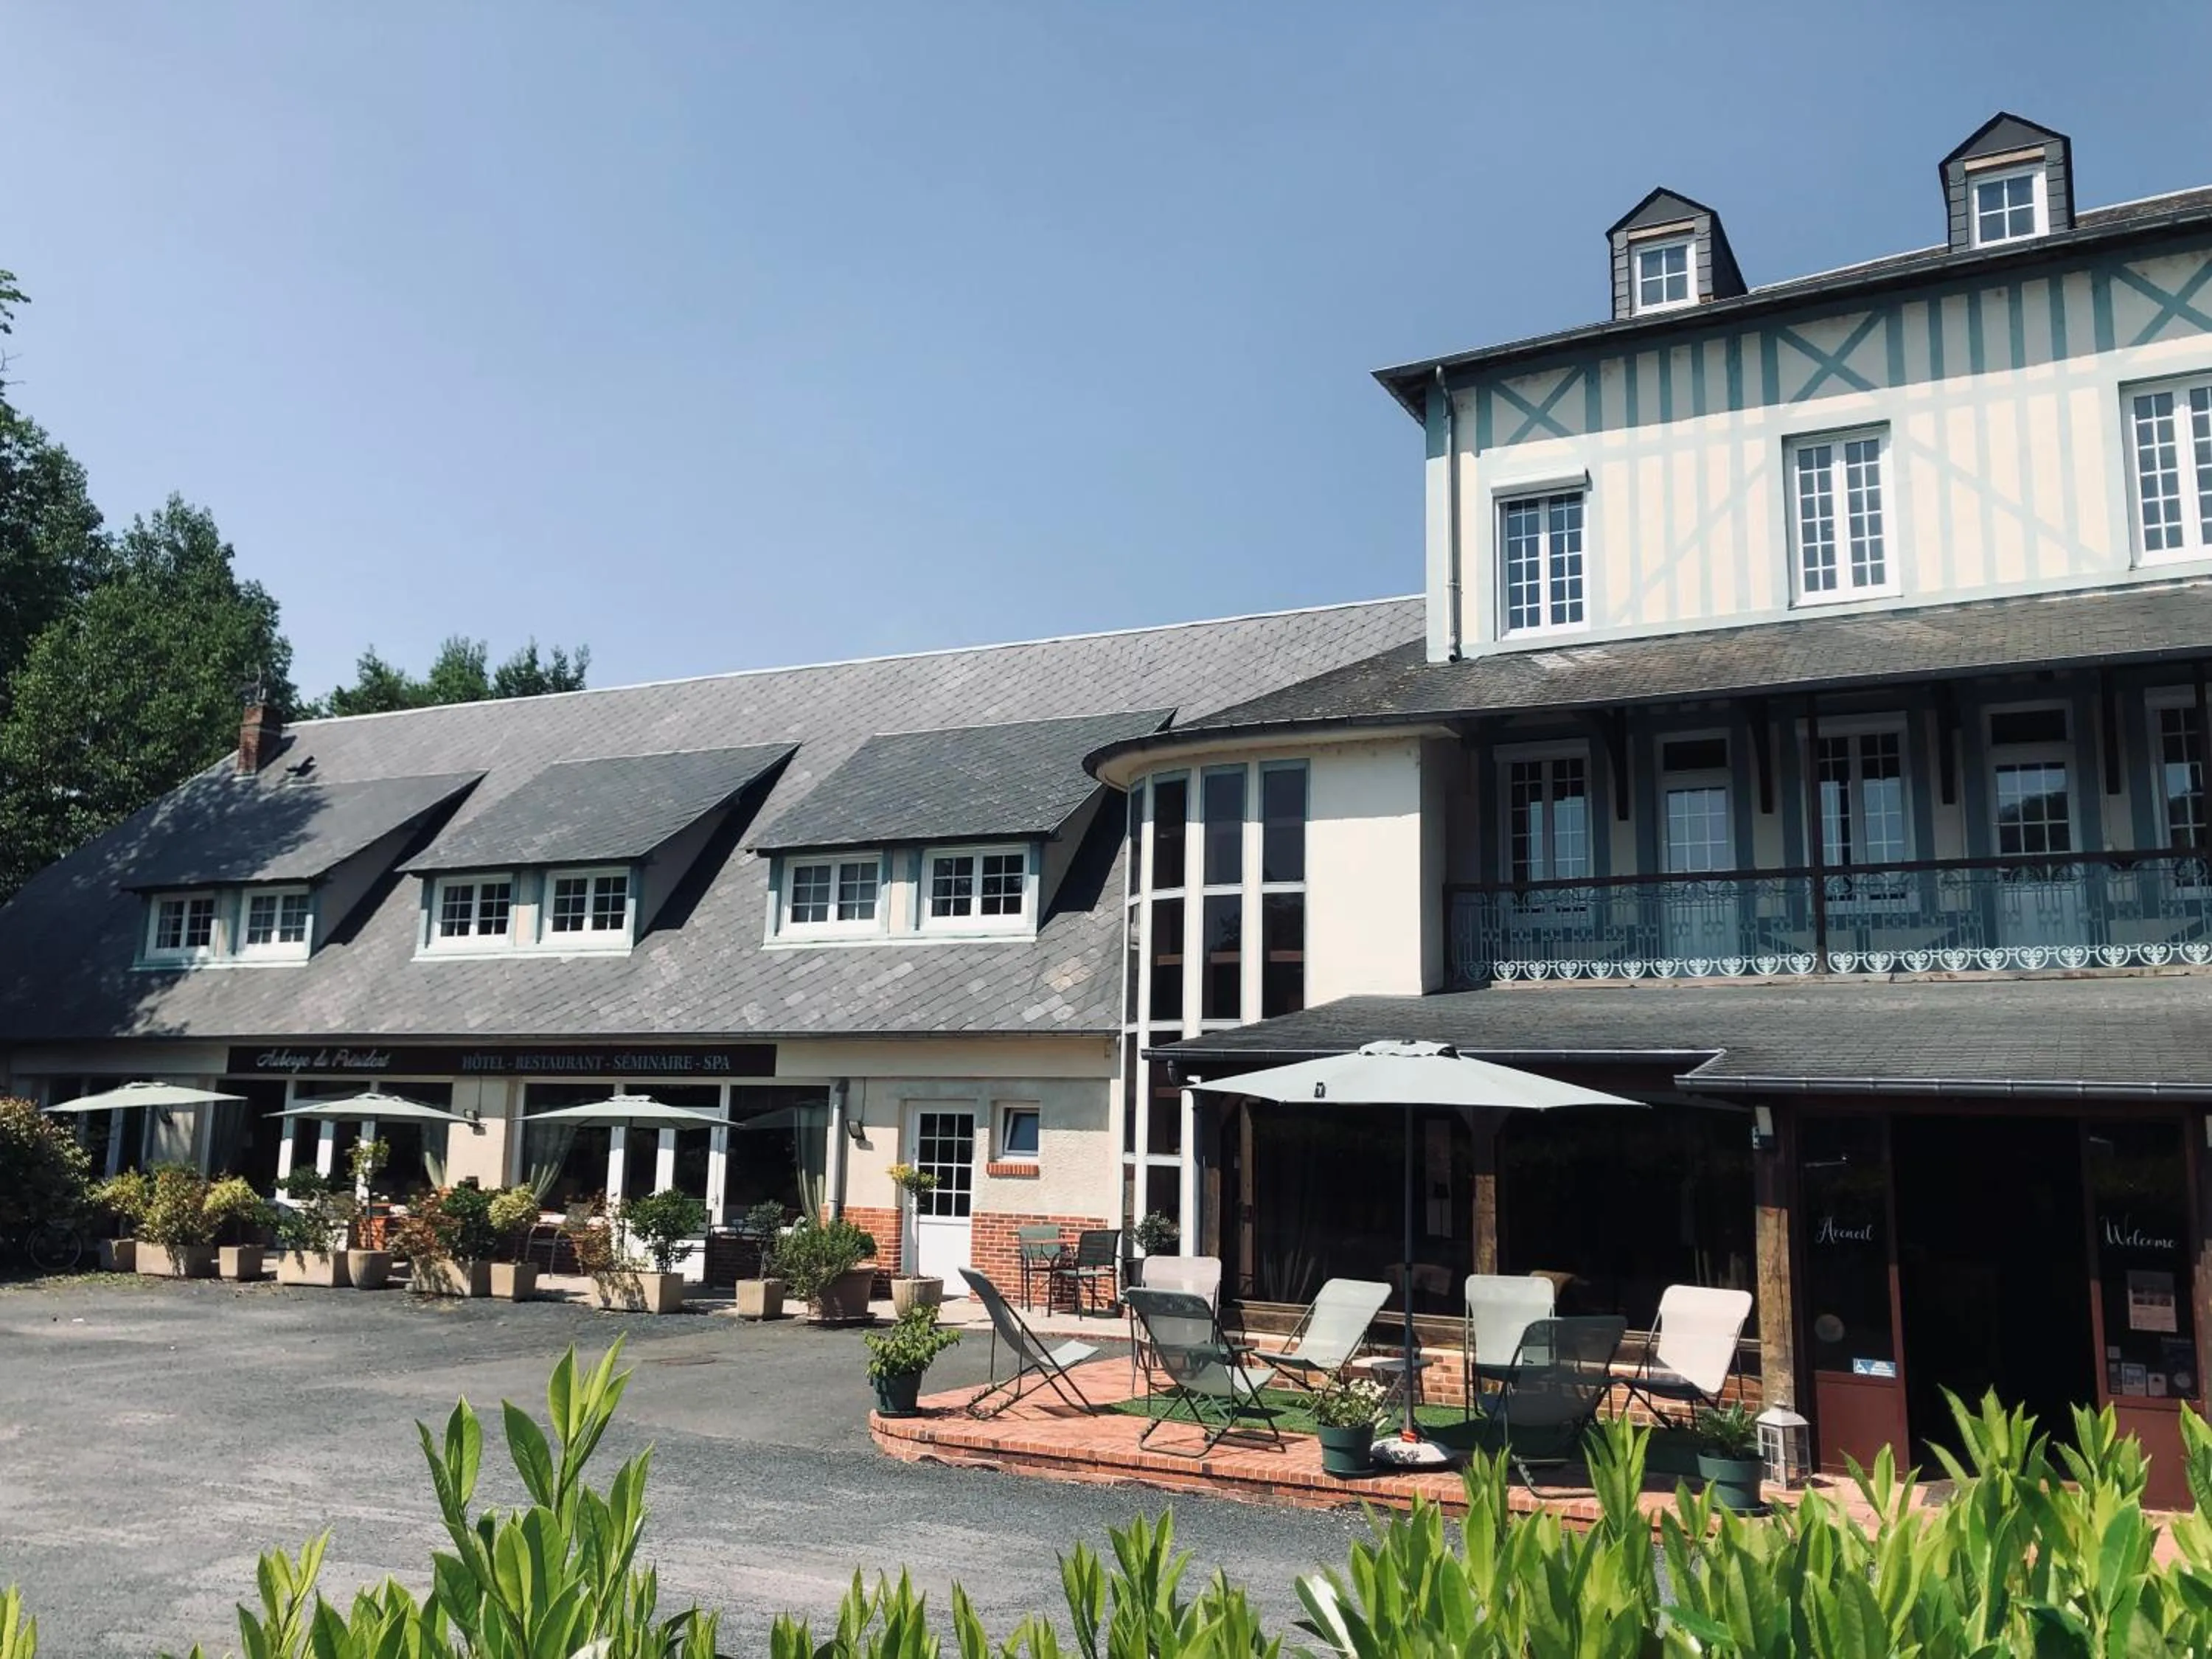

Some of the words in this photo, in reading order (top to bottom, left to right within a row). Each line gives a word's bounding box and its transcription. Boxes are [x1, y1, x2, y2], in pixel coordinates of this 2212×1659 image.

[257, 1048, 310, 1073] Auberge
[462, 1052, 505, 1070] HÔTEL
[515, 1054, 603, 1070] RESTAURANT
[613, 1052, 692, 1070] SÉMINAIRE
[703, 1054, 730, 1070] SPA
[2099, 1213, 2176, 1248] Welcome
